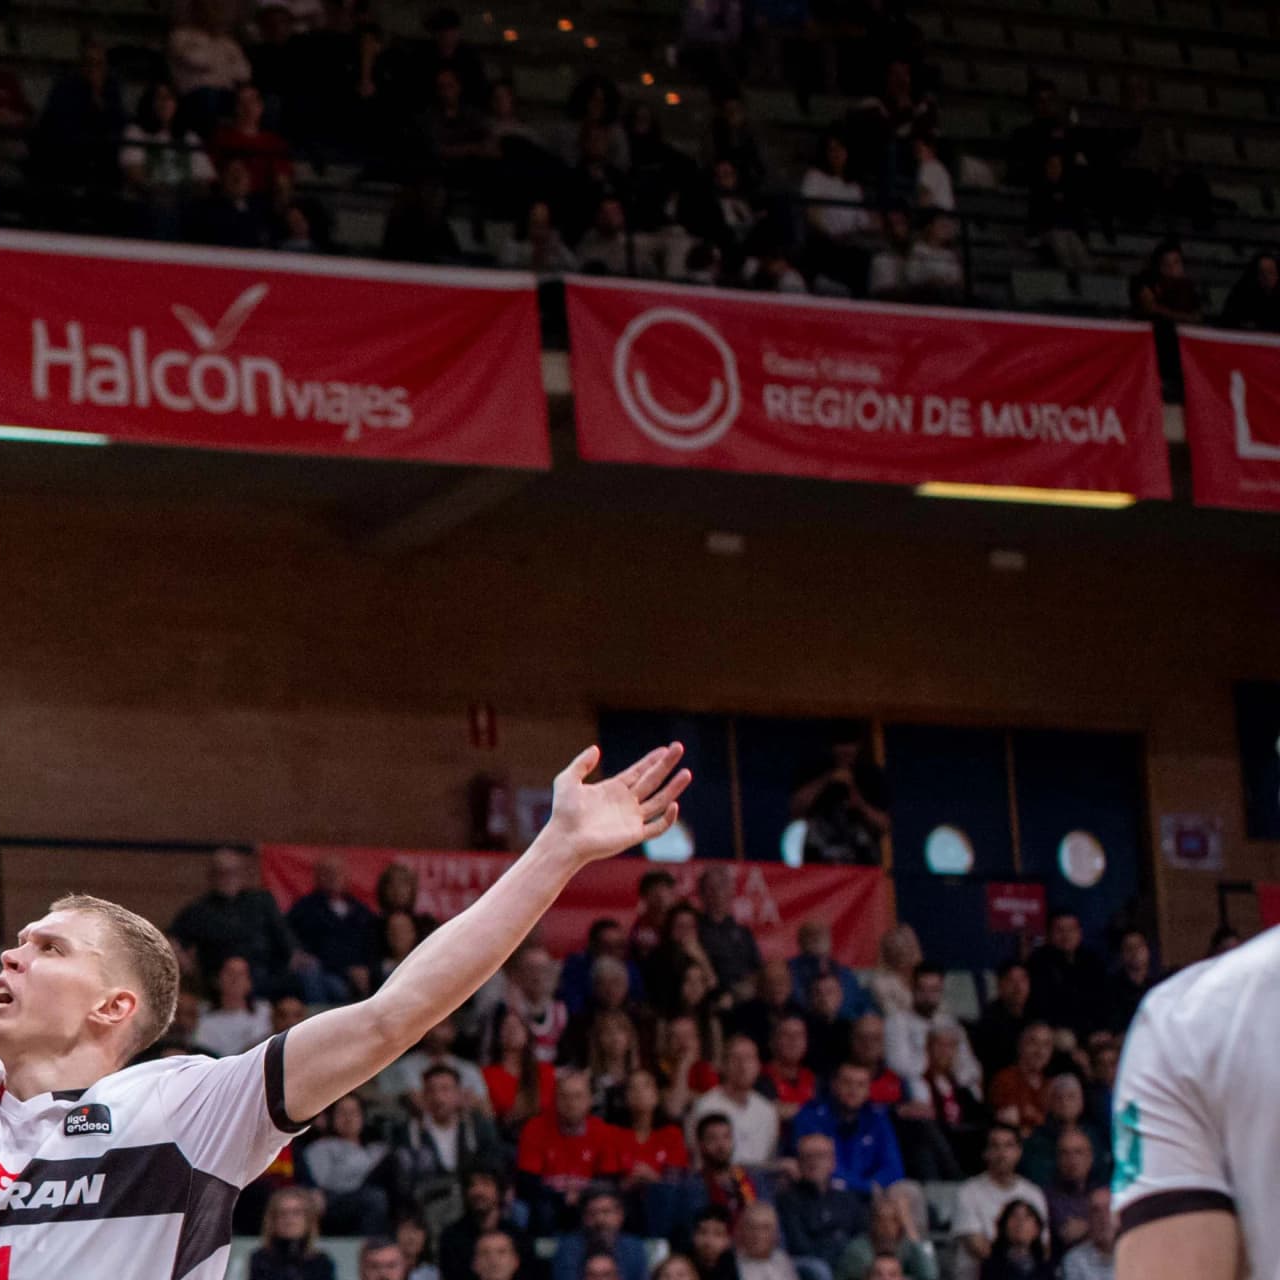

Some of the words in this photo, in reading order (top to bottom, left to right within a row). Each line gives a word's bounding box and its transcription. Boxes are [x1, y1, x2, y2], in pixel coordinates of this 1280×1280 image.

[920, 396, 972, 438] DE
[981, 400, 1127, 446] MURCIA
[66, 1118, 110, 1133] endesa
